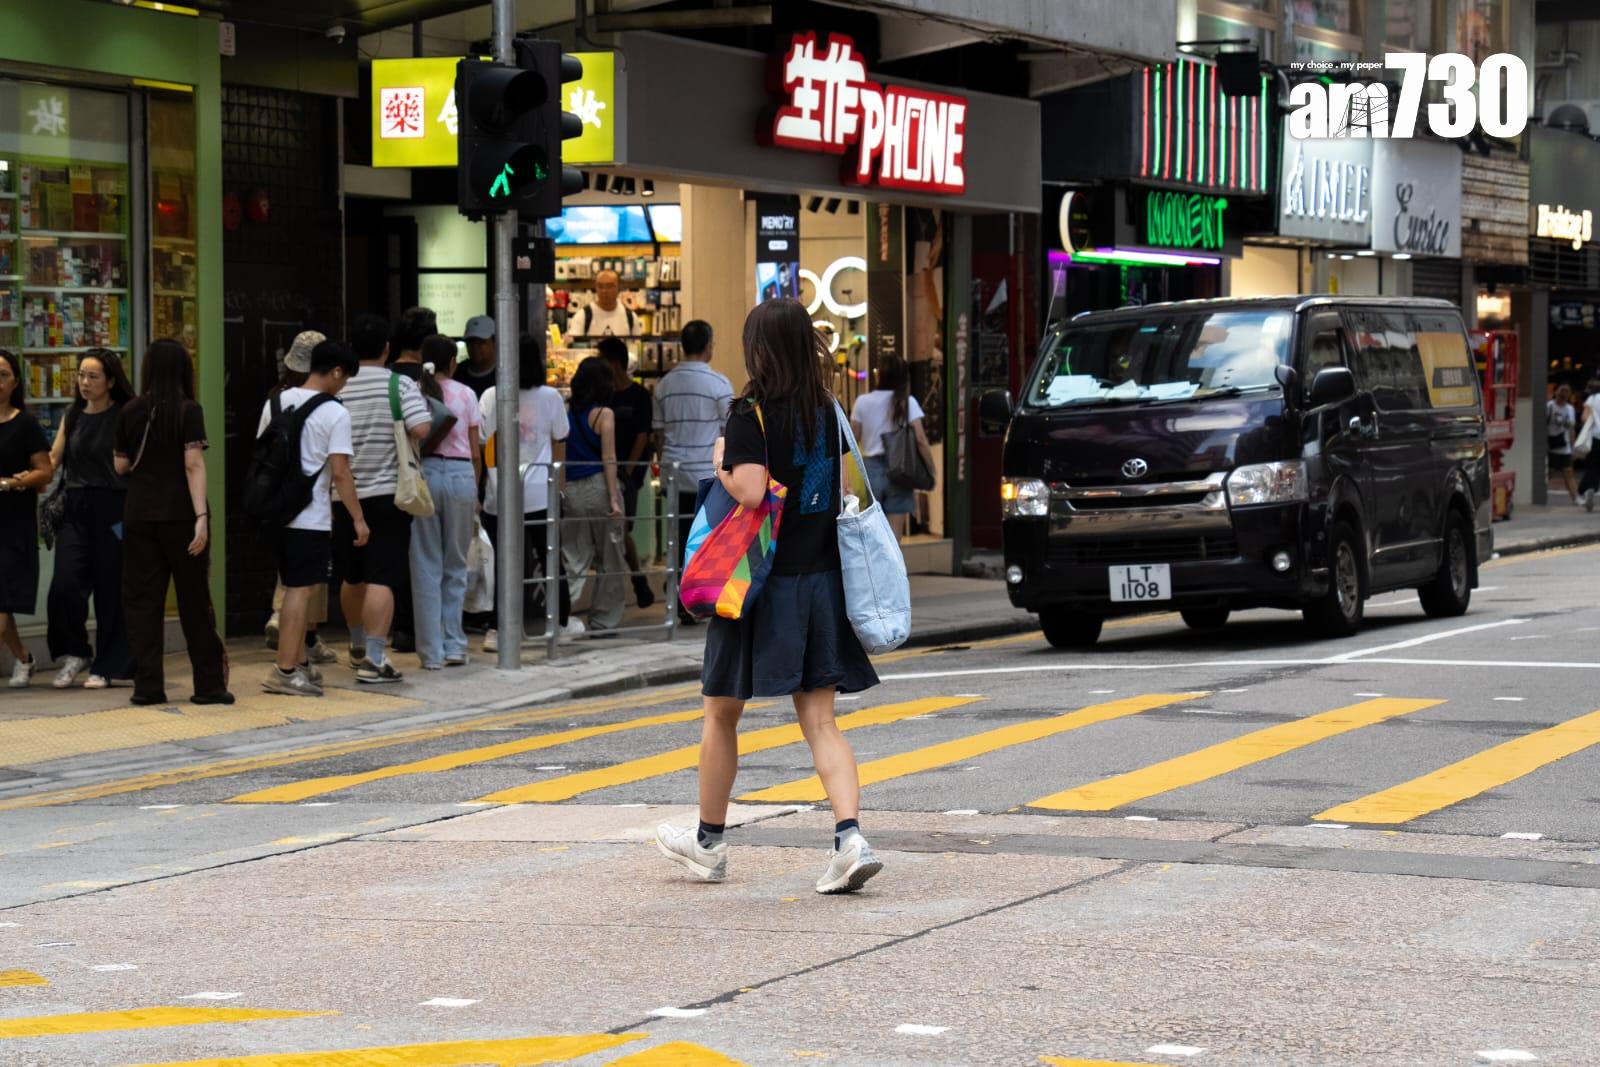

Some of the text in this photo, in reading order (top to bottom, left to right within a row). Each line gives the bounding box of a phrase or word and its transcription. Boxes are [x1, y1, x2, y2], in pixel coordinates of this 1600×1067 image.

[859, 88, 966, 187] PHONE
[1147, 191, 1229, 250] MOMENT
[1394, 182, 1450, 254] Eunice
[1121, 582, 1160, 599] 1108
[1126, 566, 1152, 583] LT
